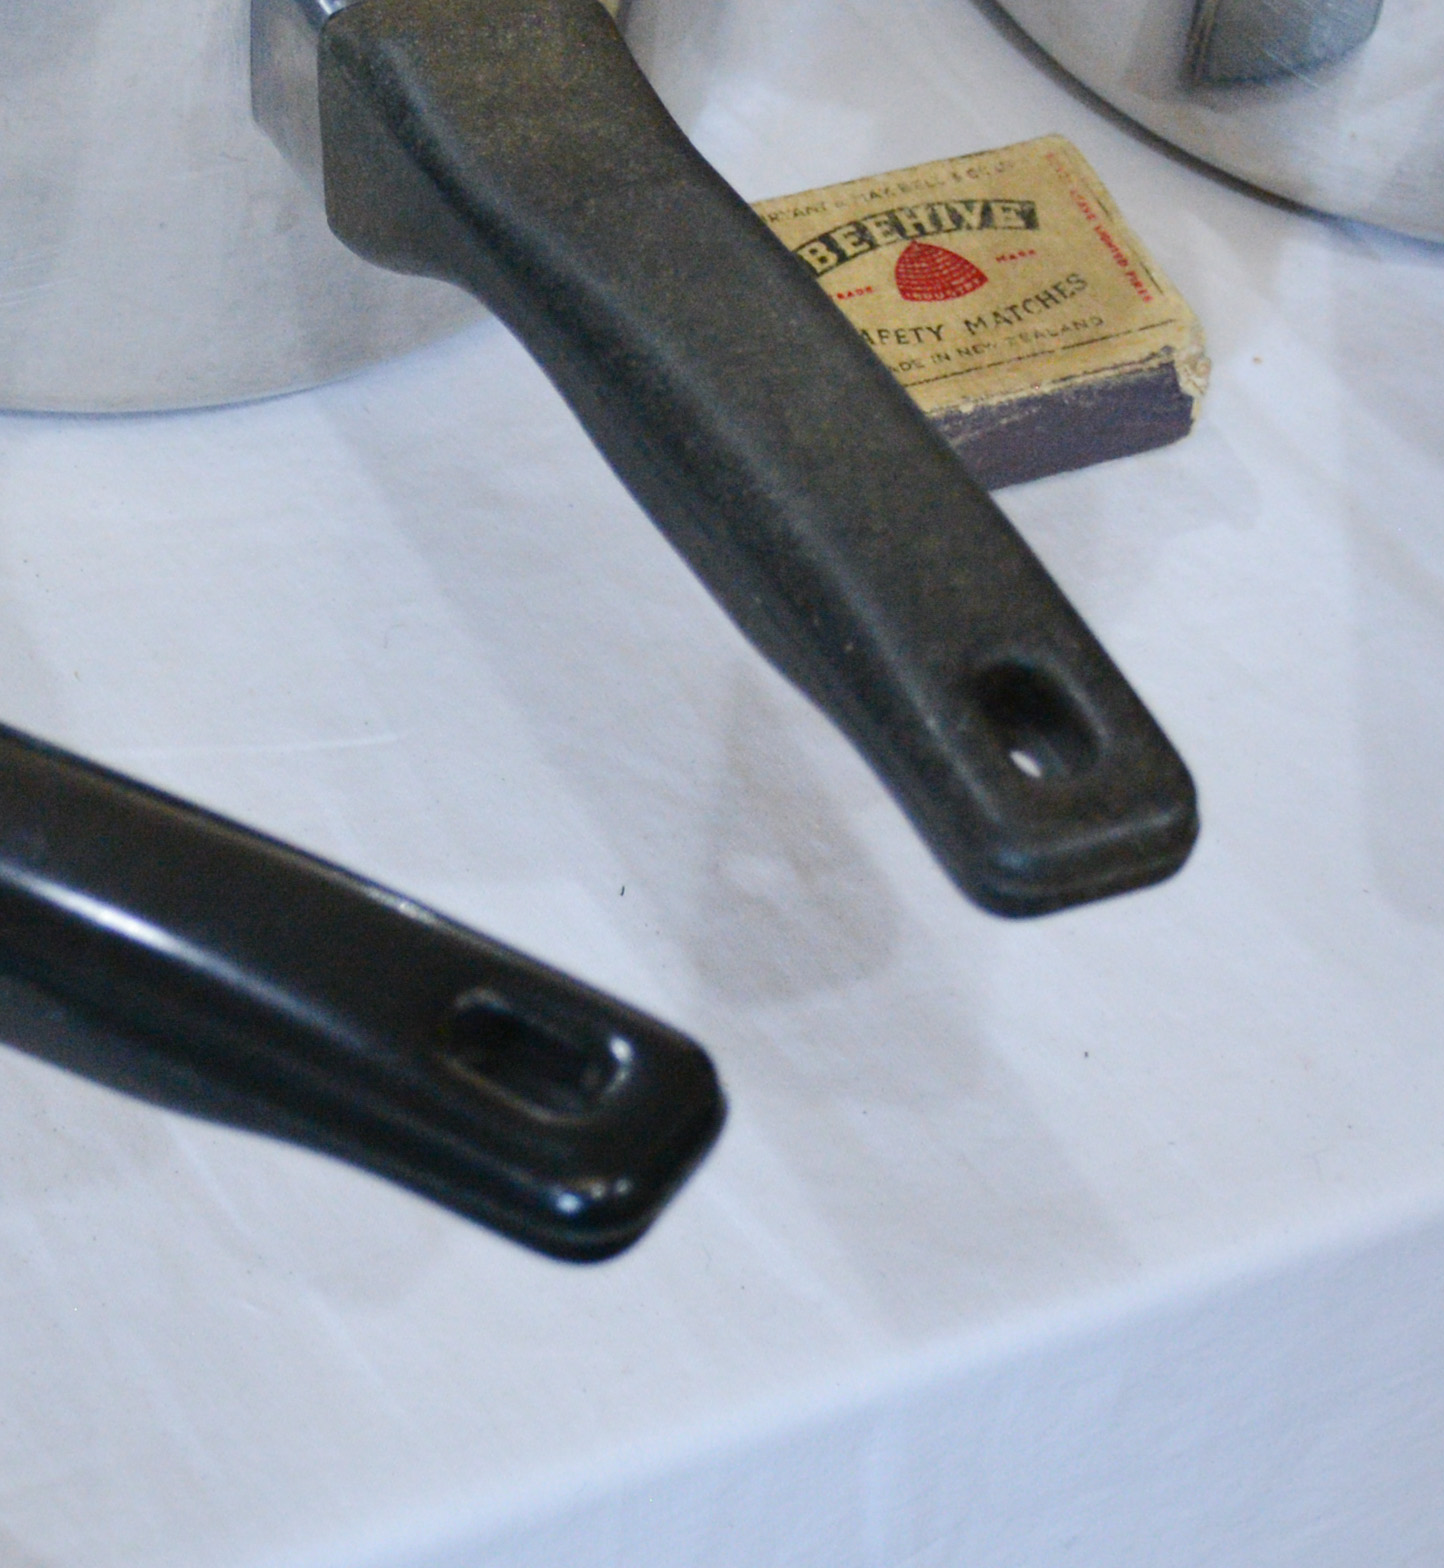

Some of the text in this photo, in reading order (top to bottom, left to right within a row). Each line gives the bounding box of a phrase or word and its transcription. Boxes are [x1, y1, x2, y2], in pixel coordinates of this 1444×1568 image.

[797, 200, 1027, 275] BEEHIVE
[829, 285, 873, 300] RADE
[860, 273, 1088, 345] AFETY MATCHES
